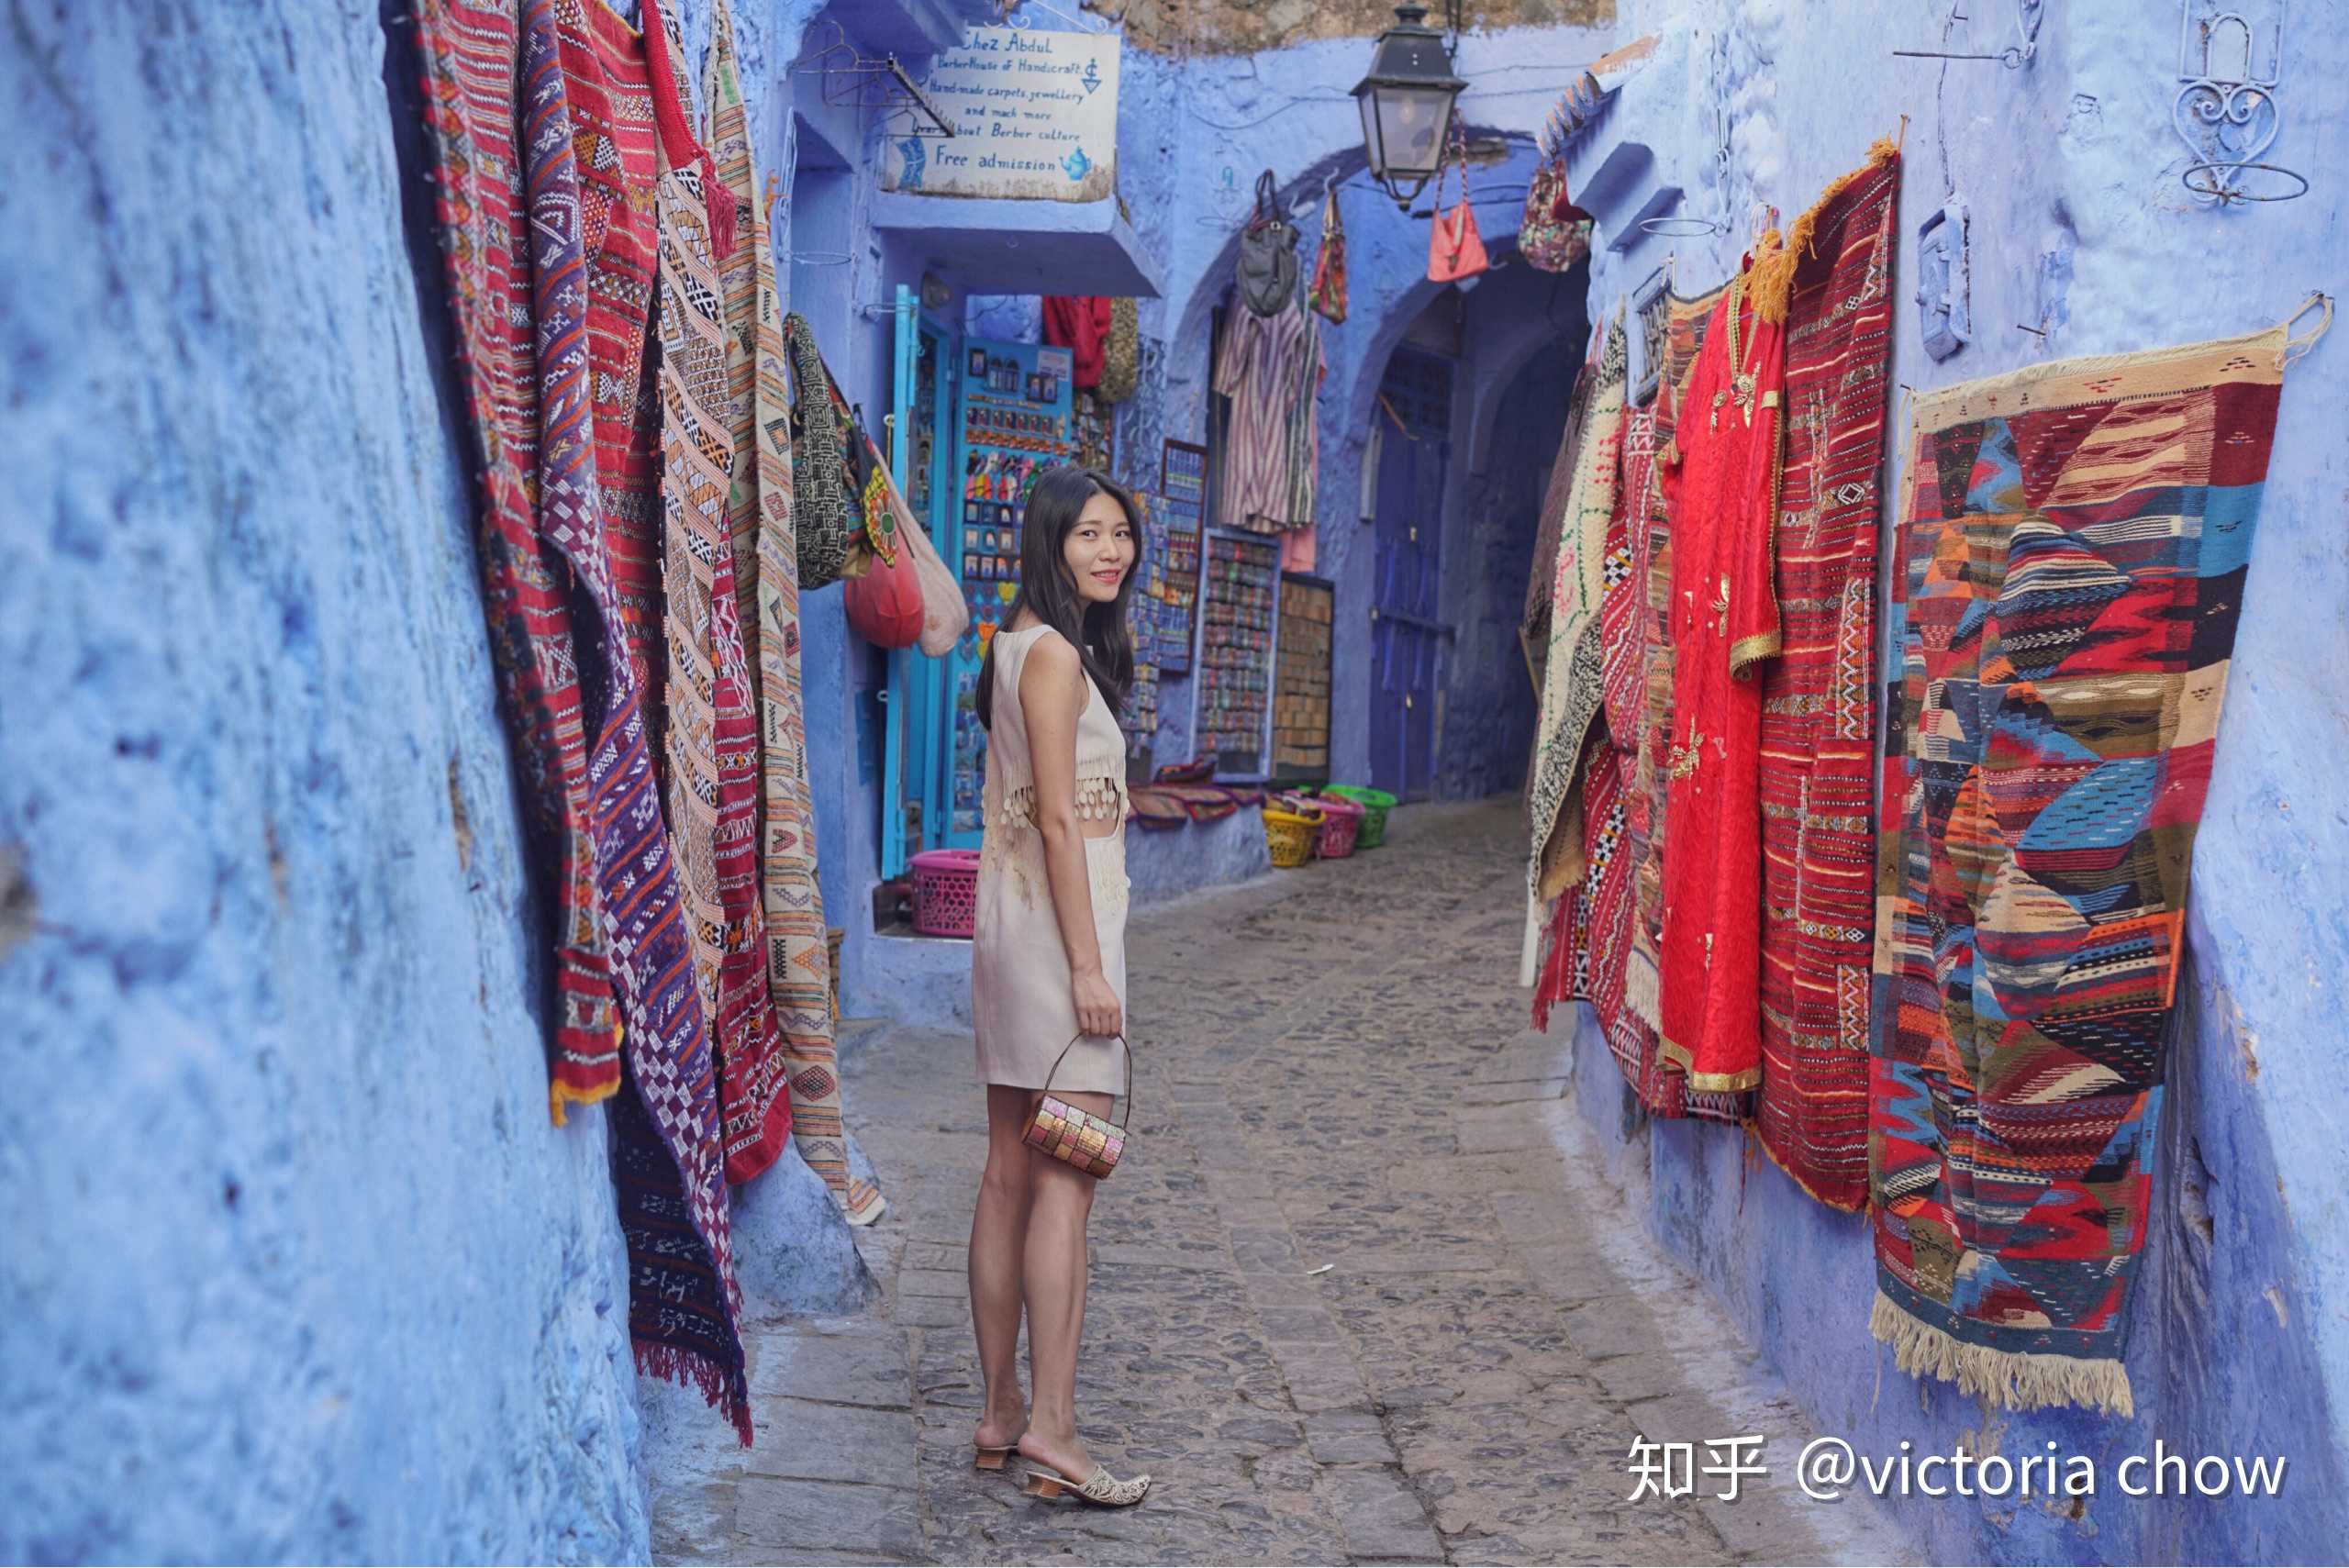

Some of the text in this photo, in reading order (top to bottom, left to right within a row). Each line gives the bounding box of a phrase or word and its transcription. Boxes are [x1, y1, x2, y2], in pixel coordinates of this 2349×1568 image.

[965, 106, 985, 117] and
[1023, 112, 1052, 120] more
[911, 117, 1080, 141] Lear bout Berber culture
[936, 144, 1055, 172] Free admission
